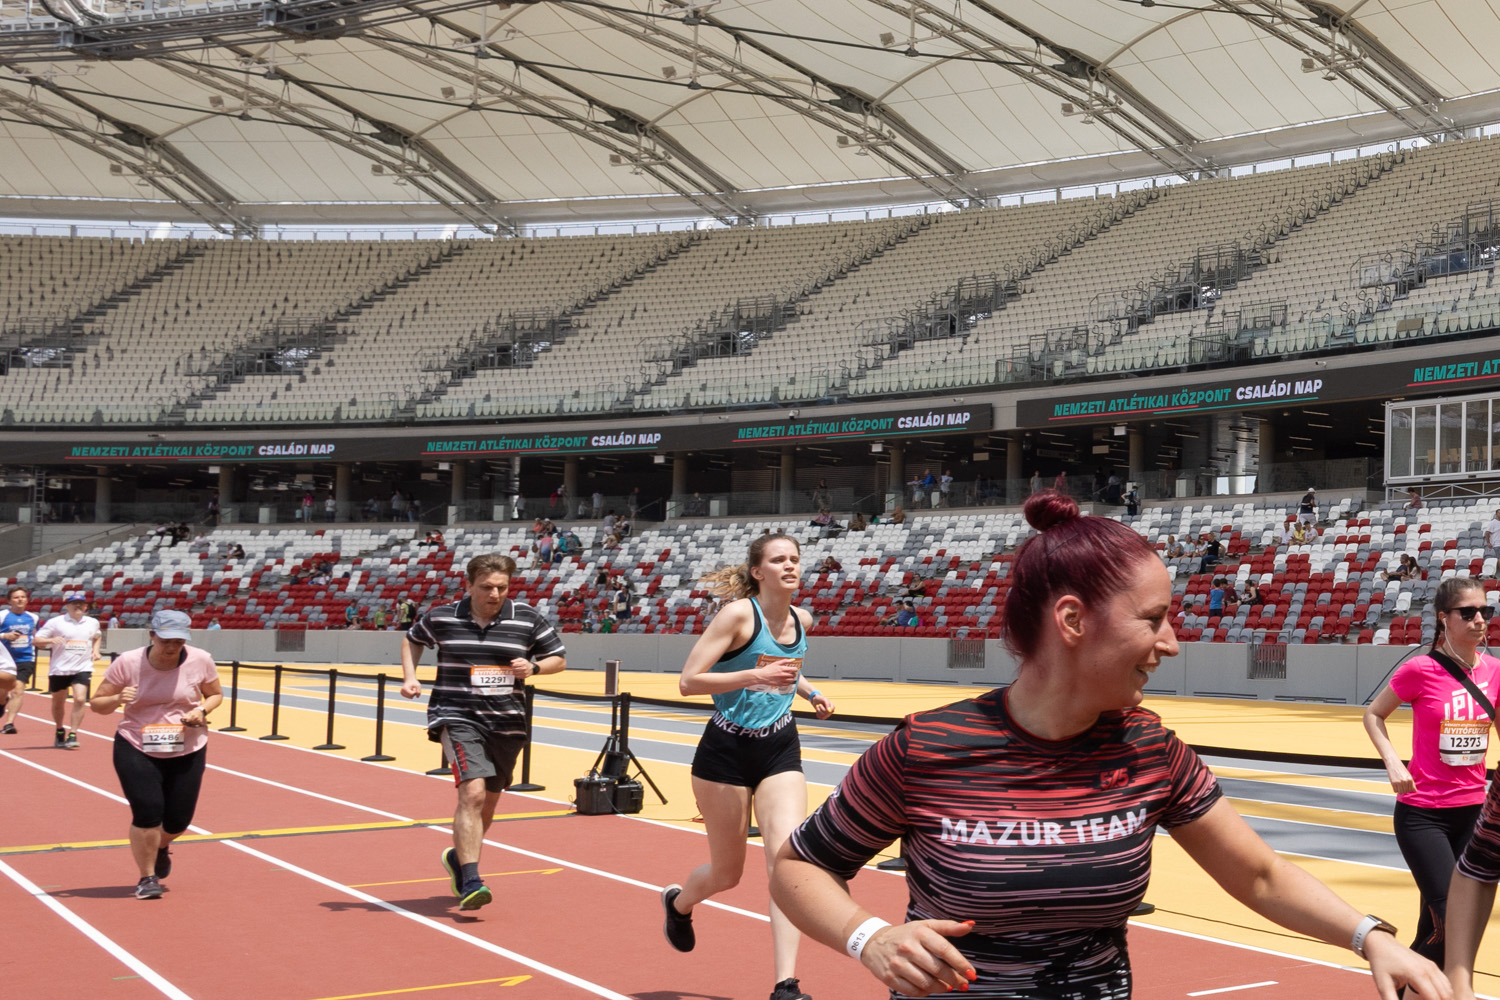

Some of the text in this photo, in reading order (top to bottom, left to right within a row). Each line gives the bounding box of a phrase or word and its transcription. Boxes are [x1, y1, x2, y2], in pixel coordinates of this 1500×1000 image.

[1413, 361, 1478, 382] NEMZETI
[1054, 379, 1323, 417] NEMZETI ATLÉTIKAI KÖZPONT CSALÁDI NAP
[738, 412, 971, 439] NEMZETI ATLÉTIKAI KÖZPONT CSALÁDI NAP
[71, 442, 335, 457] NEMZETI ATLÉTIKAI KÖZPONT CSALÁDI NAP
[427, 432, 662, 451] NEMZETI ATLÉTIKAI KÖZPONT CSALÁDI NAP
[480, 676, 506, 684] 12291
[712, 711, 741, 734] NIKE
[738, 726, 770, 738] PRO
[940, 807, 1147, 846] MAZUR TEAM
[850, 932, 866, 951] 0613
